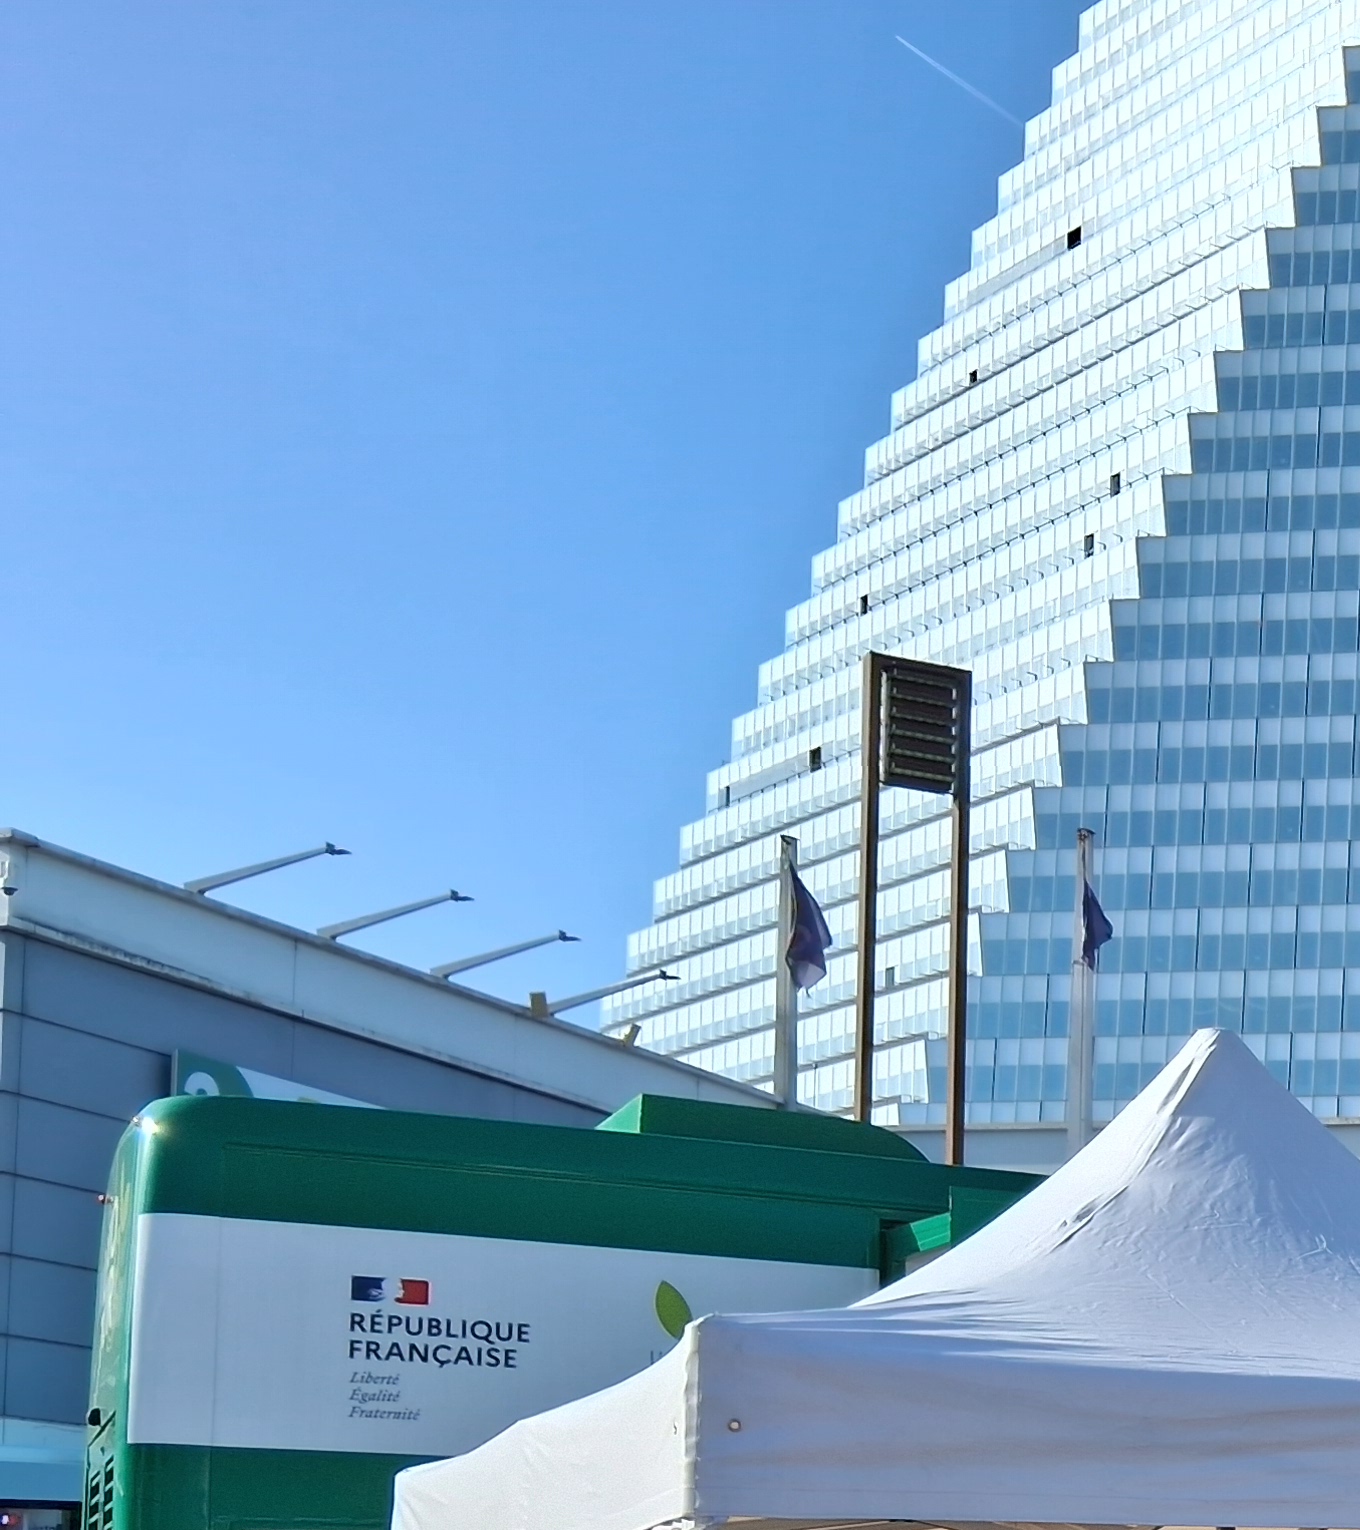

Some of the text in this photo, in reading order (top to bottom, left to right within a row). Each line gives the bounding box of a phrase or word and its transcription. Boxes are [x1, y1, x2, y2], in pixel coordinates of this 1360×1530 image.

[350, 1309, 530, 1344] RÉPUBLIQUE
[349, 1340, 518, 1368] FRANÇAISE
[350, 1371, 400, 1385] Liberté
[350, 1386, 400, 1404] Égalité
[349, 1406, 420, 1421] Fraternité
